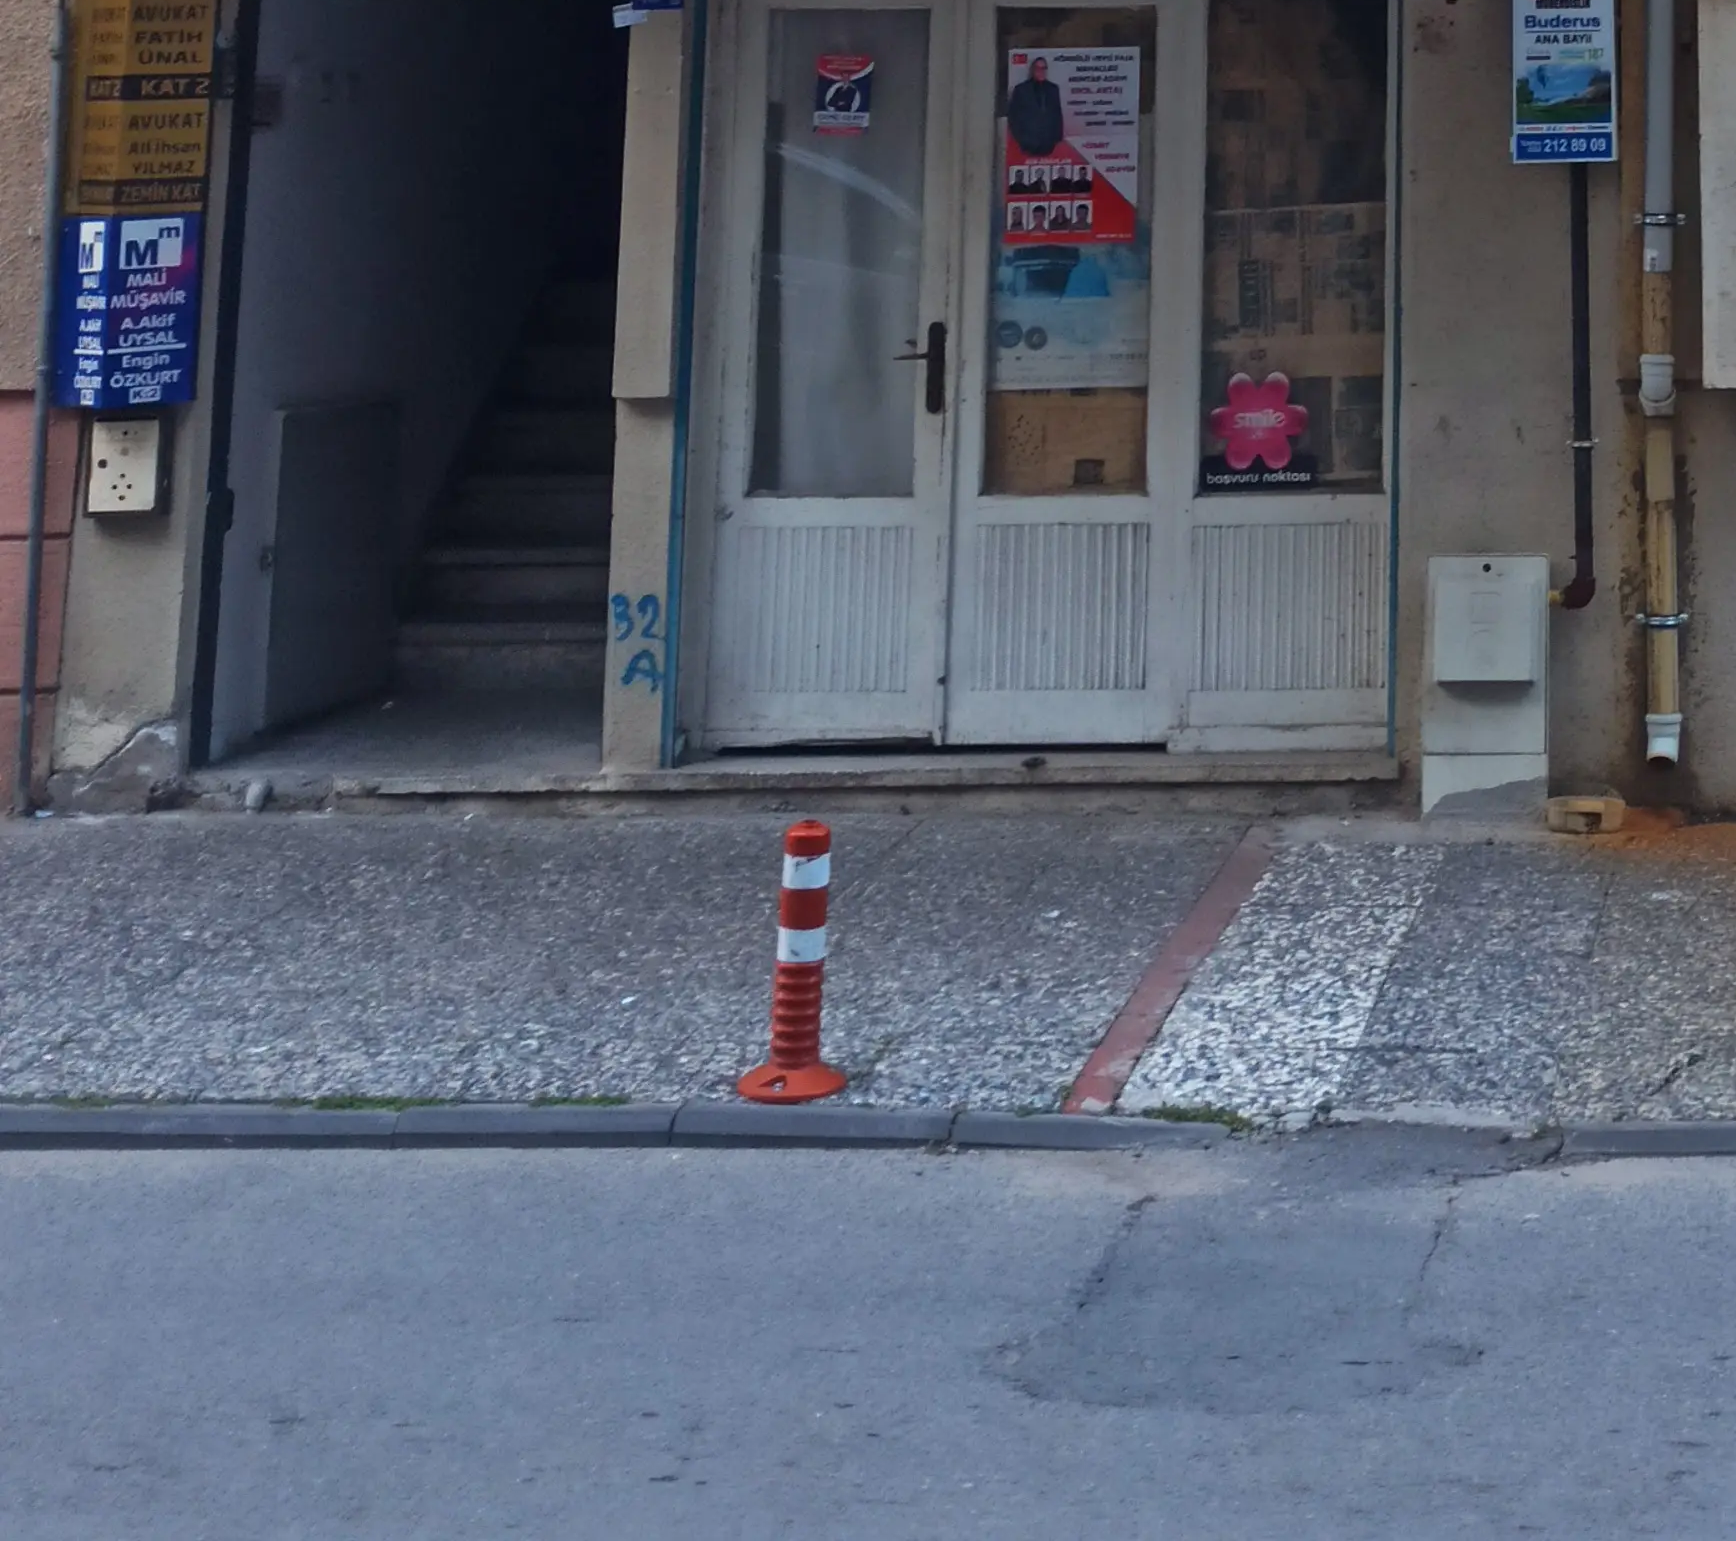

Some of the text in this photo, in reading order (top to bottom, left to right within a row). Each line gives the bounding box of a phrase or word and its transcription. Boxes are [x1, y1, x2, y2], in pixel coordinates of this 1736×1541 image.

[133, 4, 208, 23] AVUKAT
[1524, 15, 1601, 30] Buderus
[134, 29, 204, 45] FATİH
[1534, 34, 1560, 45] ANA
[140, 76, 211, 97] KAT 2
[127, 113, 205, 131] AVUKAT
[1542, 137, 1569, 154] 212
[131, 159, 196, 175] YILMAZ
[171, 182, 203, 201] KAT
[126, 267, 167, 289] MALİ
[110, 287, 187, 311] MÜŞAVİR
[118, 331, 179, 348] UYSAL
[121, 352, 170, 370] Engin
[109, 368, 182, 388] ÖZKURT
[1232, 408, 1287, 429] smile
